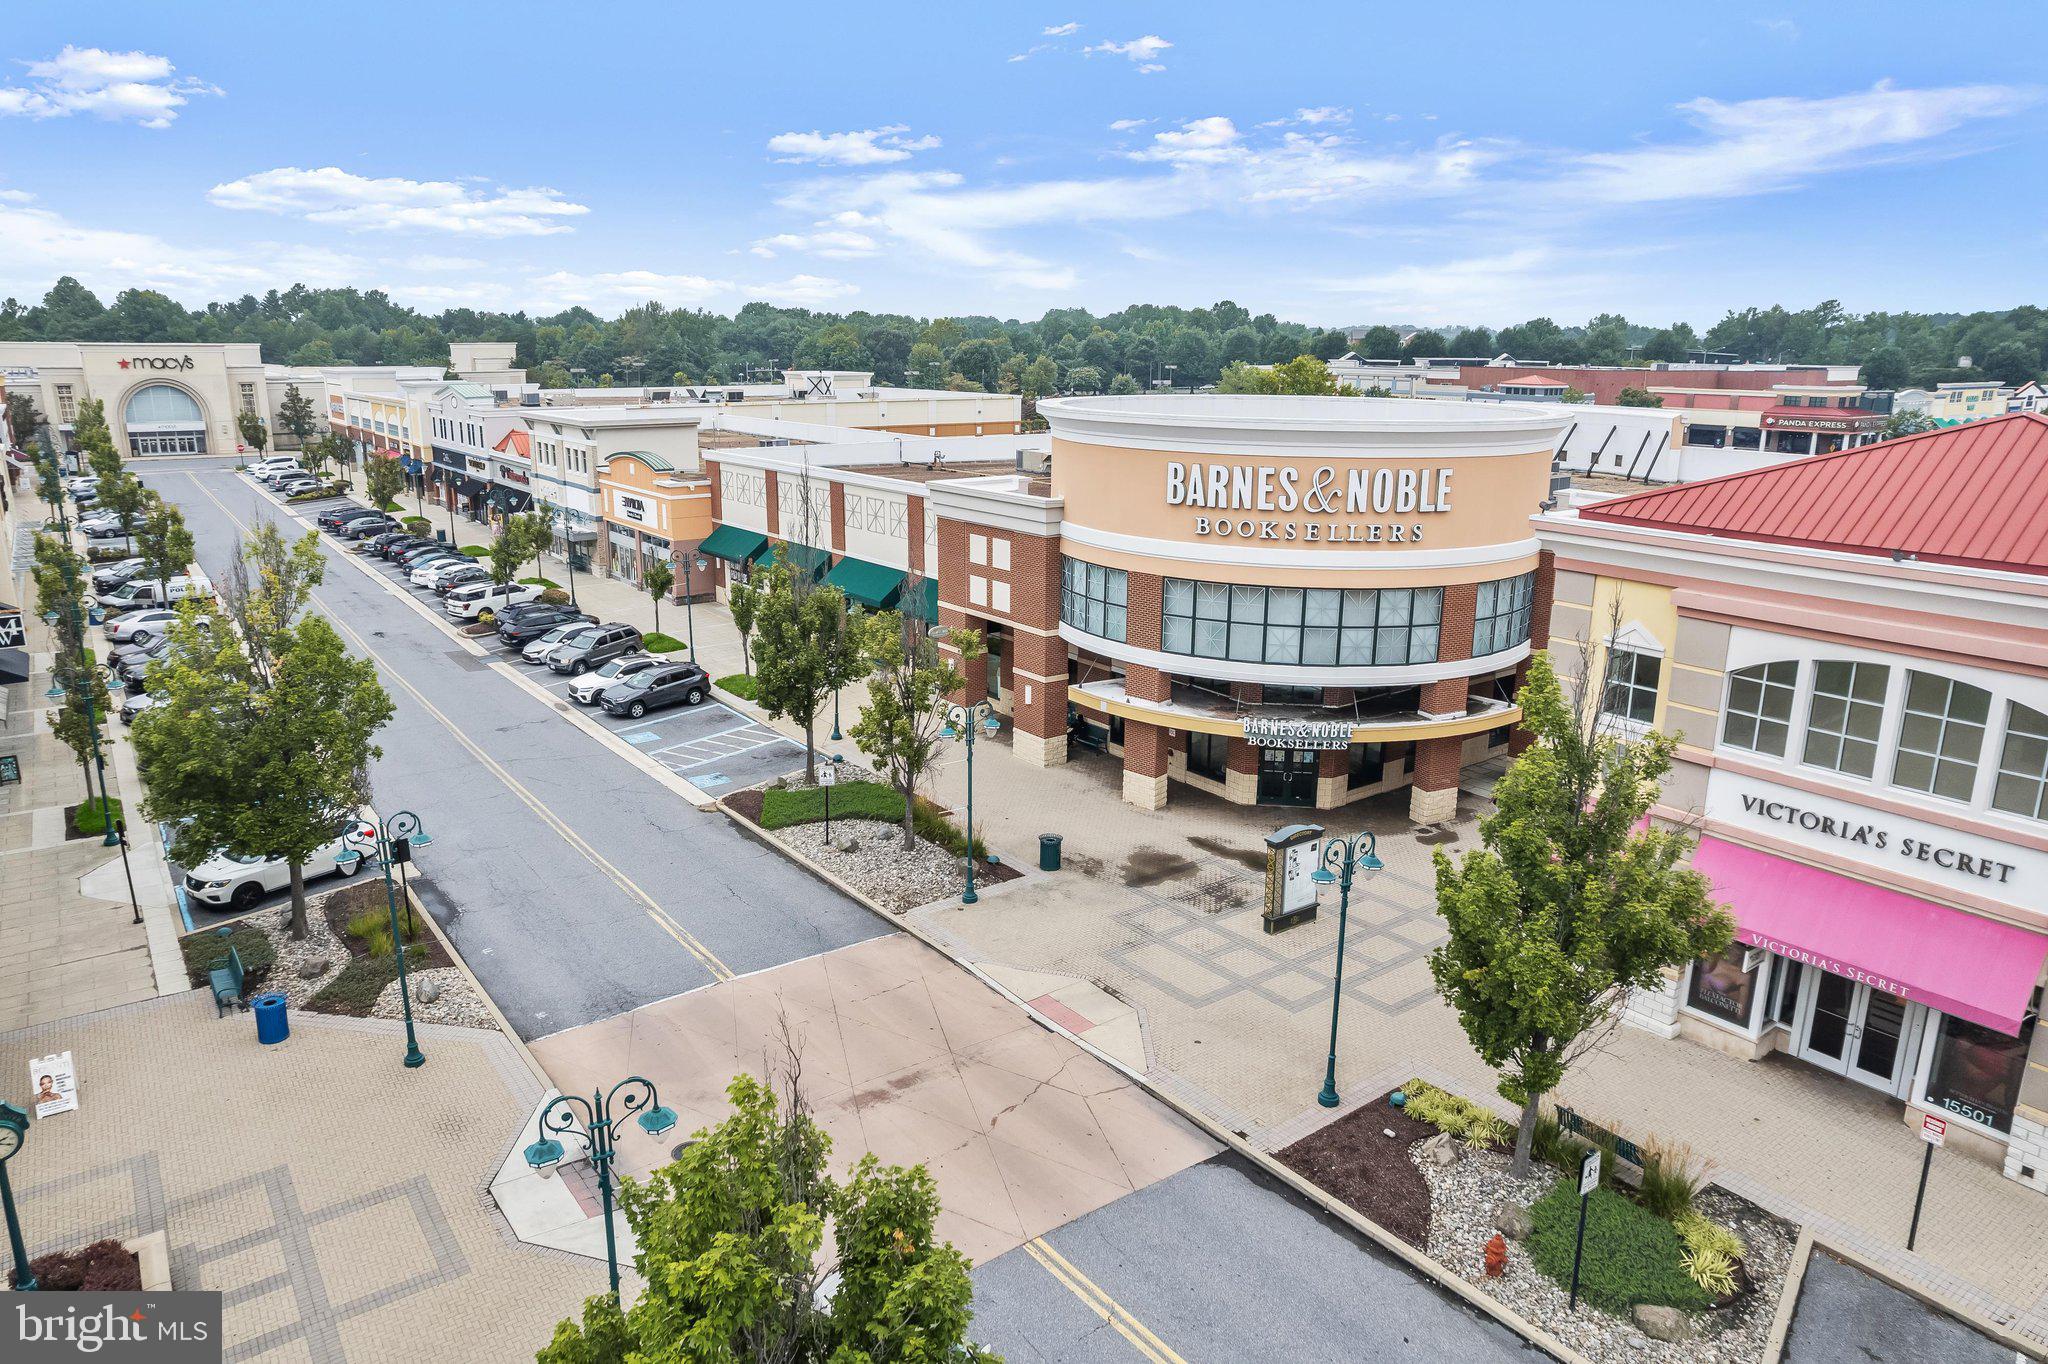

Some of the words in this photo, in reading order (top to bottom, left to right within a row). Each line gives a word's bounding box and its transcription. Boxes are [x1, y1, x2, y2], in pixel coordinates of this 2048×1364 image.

[133, 354, 194, 372] macy's
[1778, 418, 1807, 428] PANDA
[1808, 420, 1847, 430] EXPRESS
[1166, 461, 1299, 512] BARNES
[1303, 466, 1343, 513] &
[1346, 467, 1454, 513] NOBLE
[1195, 517, 1424, 542] BOOKSELLERS
[1243, 717, 1295, 737] BARNES
[1311, 722, 1354, 739] NOBLE
[1247, 736, 1348, 750] BOOKSELLERS
[1741, 794, 1889, 849] VICTORIA'S
[1901, 838, 2016, 884] SECRET
[1751, 934, 1841, 974] VICTORIA'S
[1846, 967, 1911, 997] SECRET
[1943, 1098, 1993, 1126] 15501
